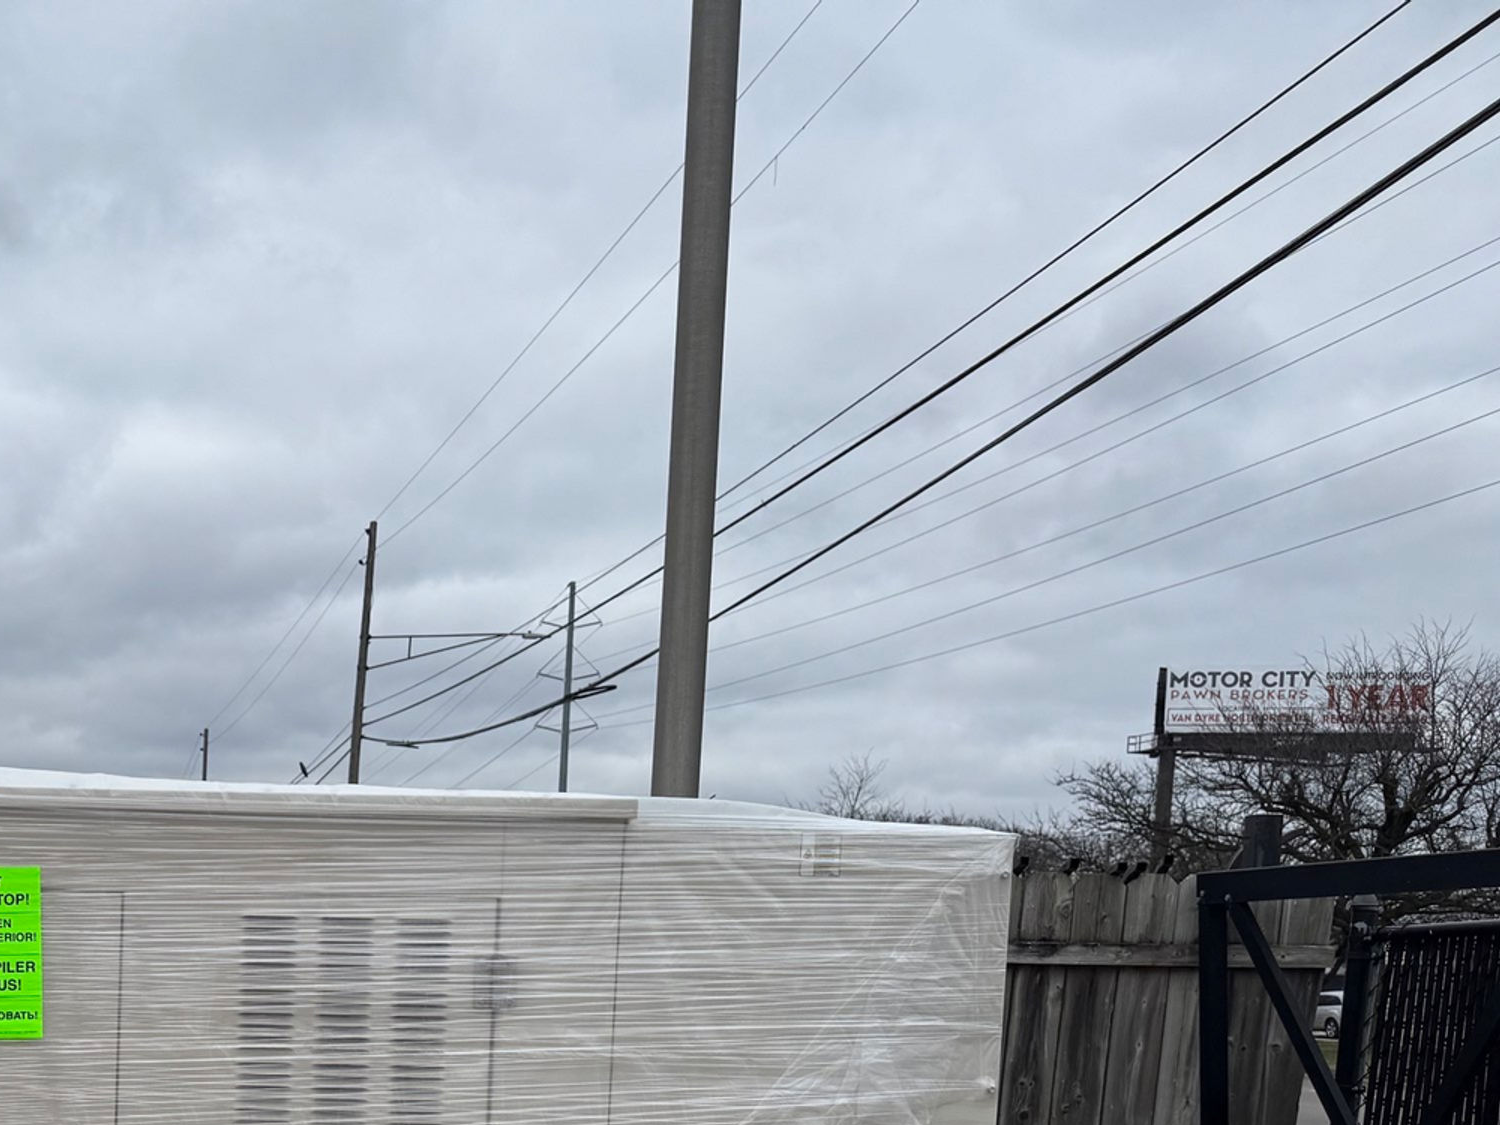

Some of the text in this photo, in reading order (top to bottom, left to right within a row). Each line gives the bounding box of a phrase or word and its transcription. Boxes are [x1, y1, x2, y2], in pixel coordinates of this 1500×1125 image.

[1170, 671, 1316, 688] MOTOR CITY
[1170, 689, 1308, 700] PAWN BROKERS
[1348, 684, 1431, 711] YEAR
[1171, 714, 1191, 722] VAN
[1195, 714, 1220, 722] DYKE
